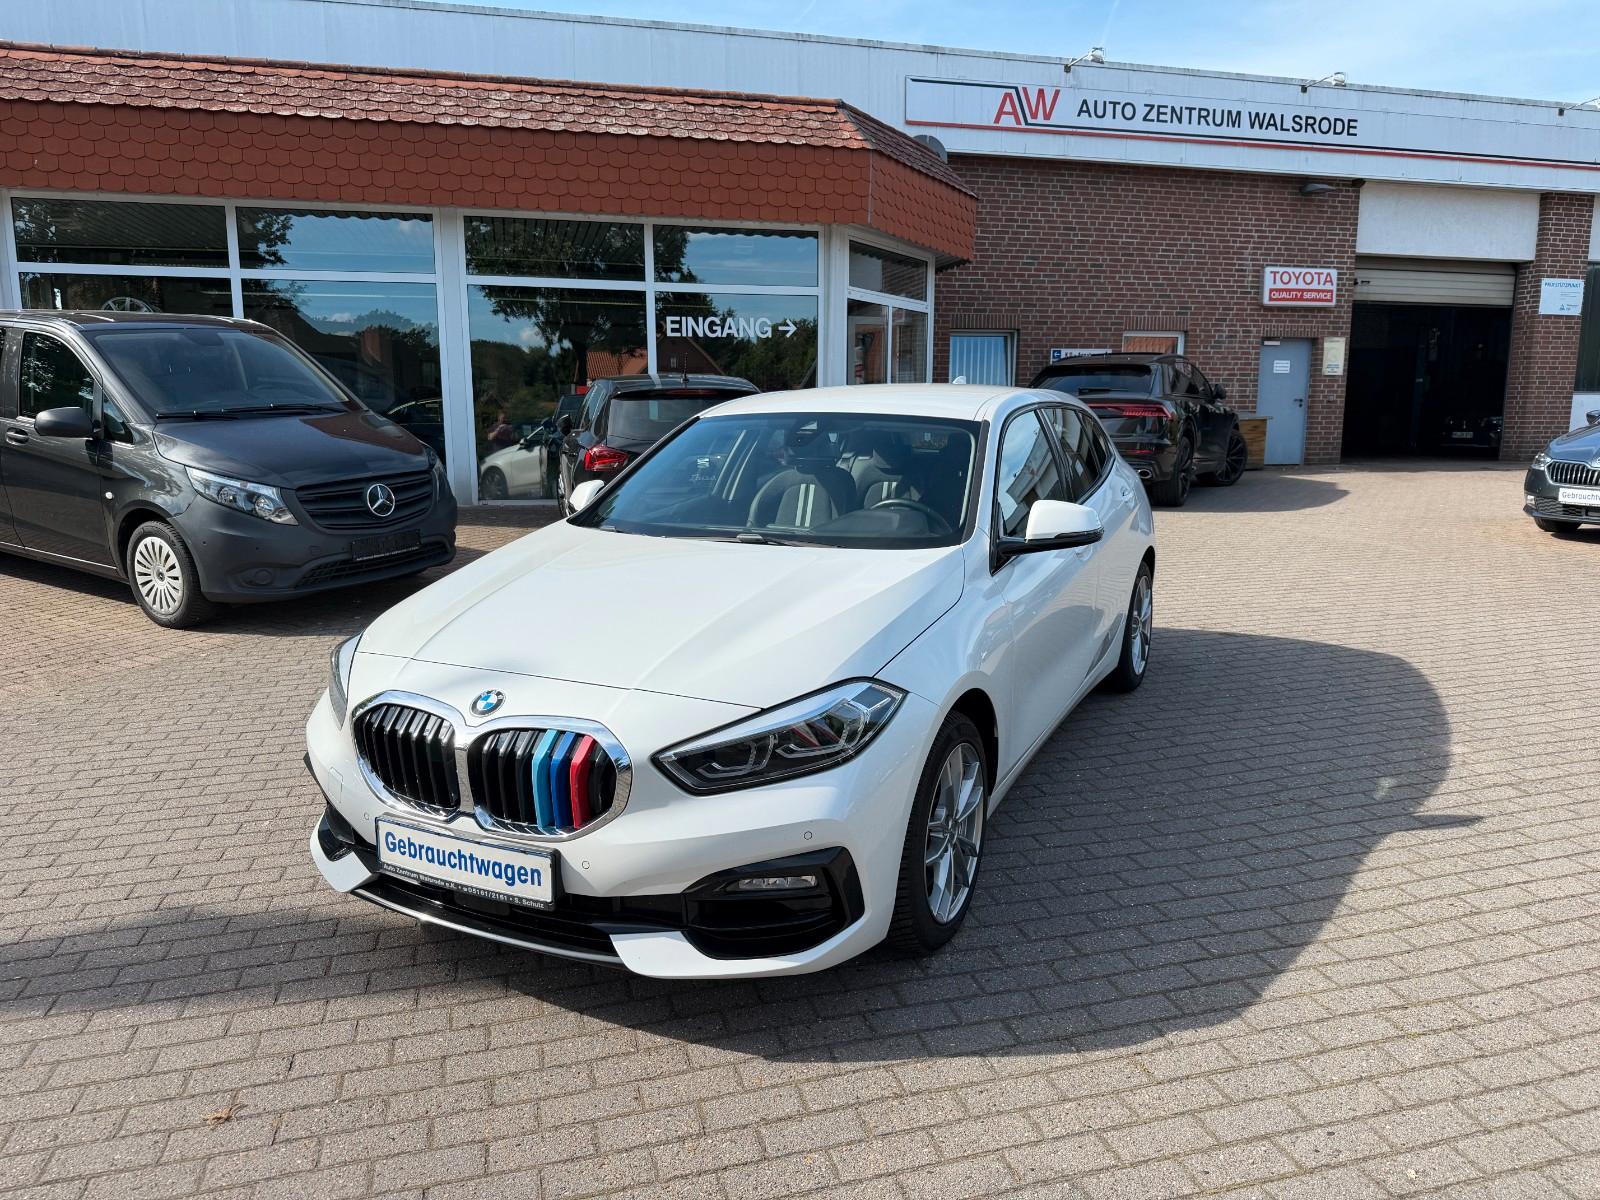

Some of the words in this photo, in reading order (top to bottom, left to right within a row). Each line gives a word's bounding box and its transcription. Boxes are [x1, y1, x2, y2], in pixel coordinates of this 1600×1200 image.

[1077, 99, 1137, 121] AUTO
[1142, 103, 1242, 129] ZENTRUM
[1248, 111, 1358, 137] WALSRODE
[1270, 271, 1334, 286] TOYOTA
[1271, 291, 1302, 299] QUALITY
[1303, 292, 1332, 300] SERVICE
[666, 316, 772, 338] EINGANG
[385, 831, 542, 887] Gebrauchtwagen
